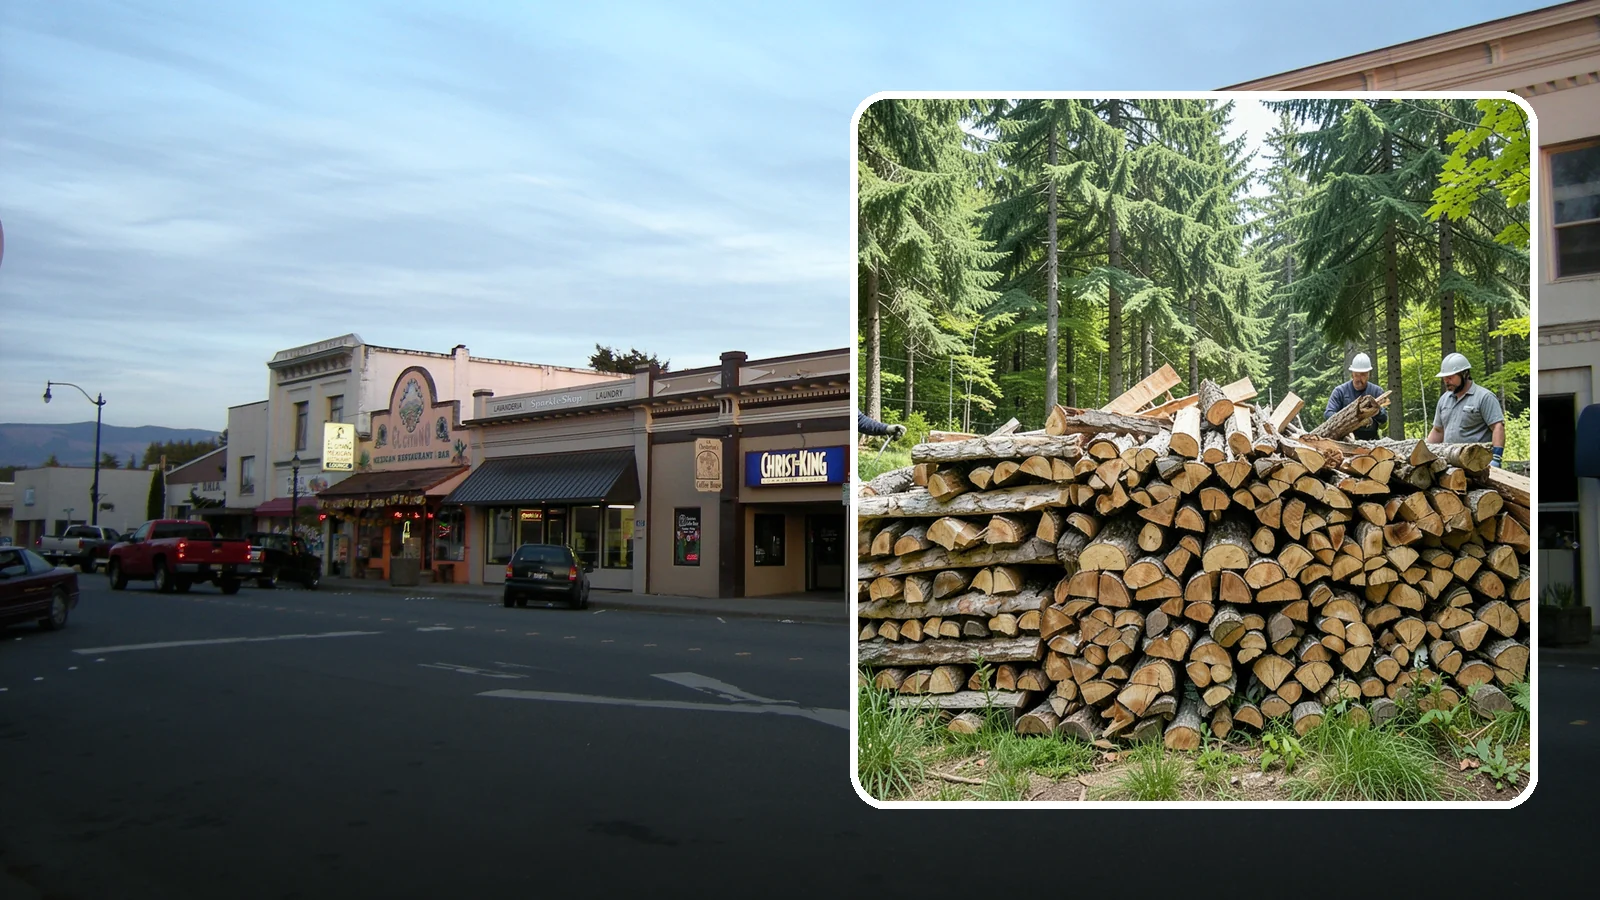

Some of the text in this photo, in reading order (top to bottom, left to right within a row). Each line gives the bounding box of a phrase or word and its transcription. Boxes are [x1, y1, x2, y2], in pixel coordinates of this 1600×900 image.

[493, 402, 523, 413] LAVANDERIA
[595, 389, 624, 400] LAUNDRY
[373, 450, 450, 464] MEXICAN RESTAURANT BAR
[799, 449, 828, 476] KING
